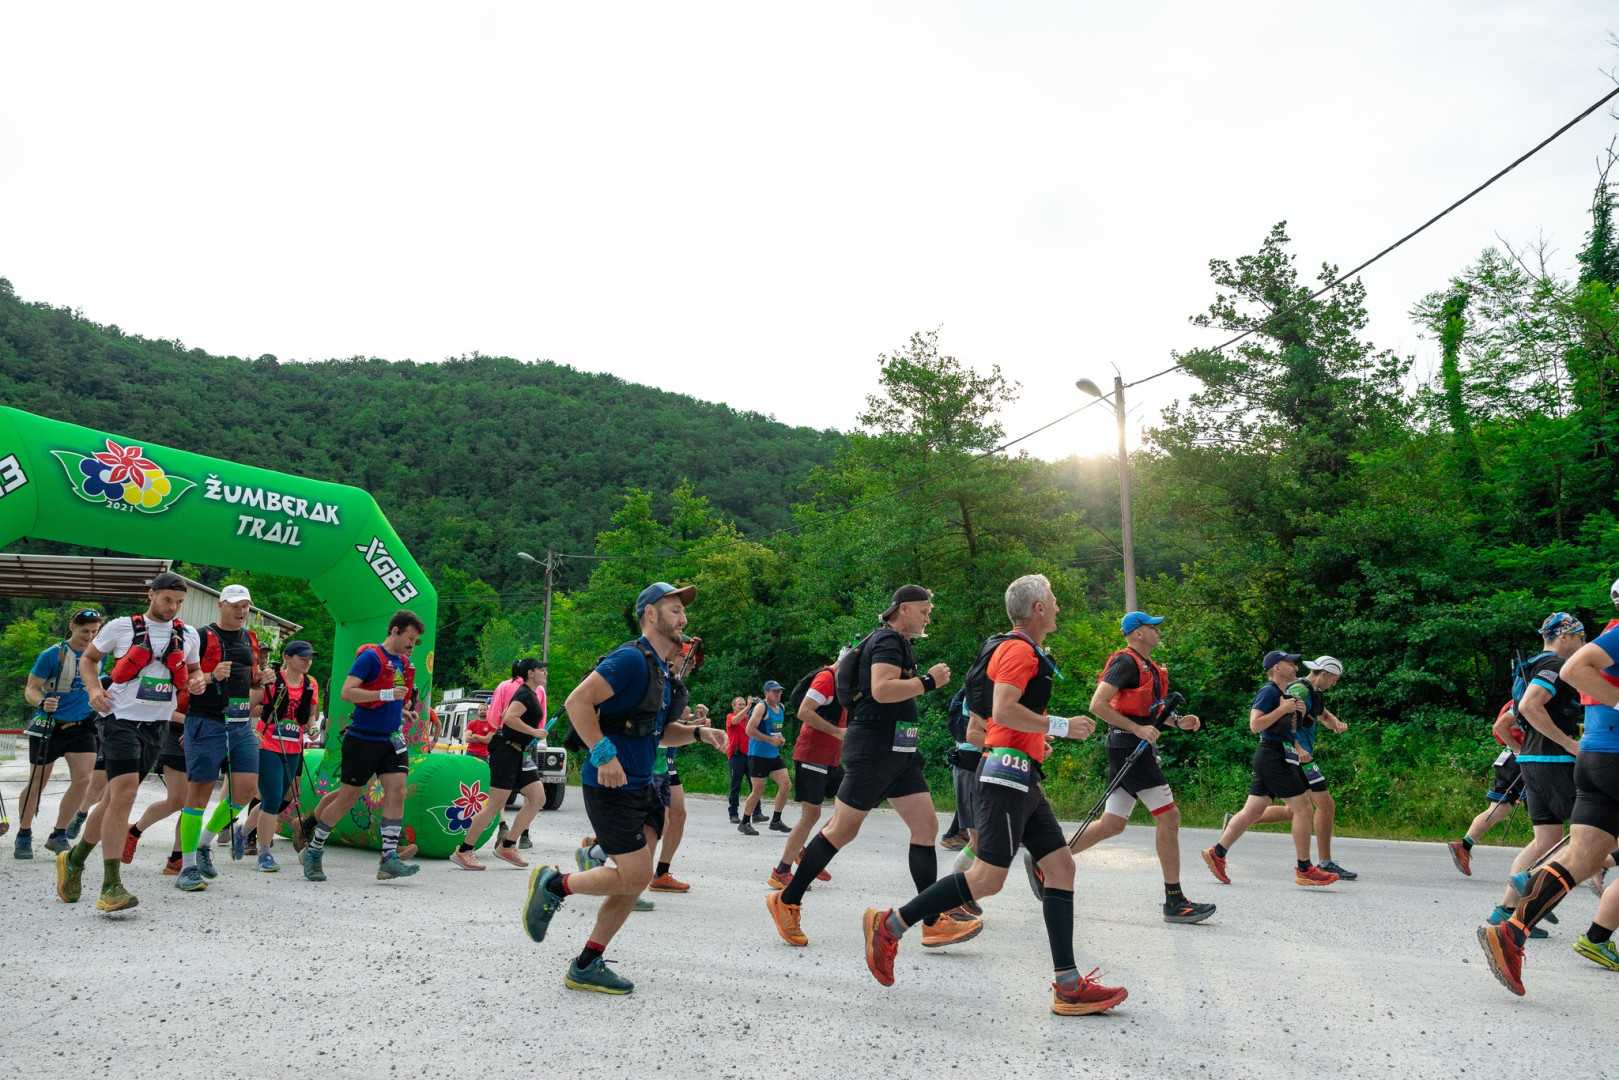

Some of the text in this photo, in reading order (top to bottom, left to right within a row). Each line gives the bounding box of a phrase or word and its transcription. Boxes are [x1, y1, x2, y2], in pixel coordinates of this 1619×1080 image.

[106, 500, 134, 513] 2021
[204, 473, 340, 525] ŽUMBERAK
[355, 535, 420, 605] XGB3
[285, 723, 300, 733] 002
[1001, 753, 1028, 772] 018
